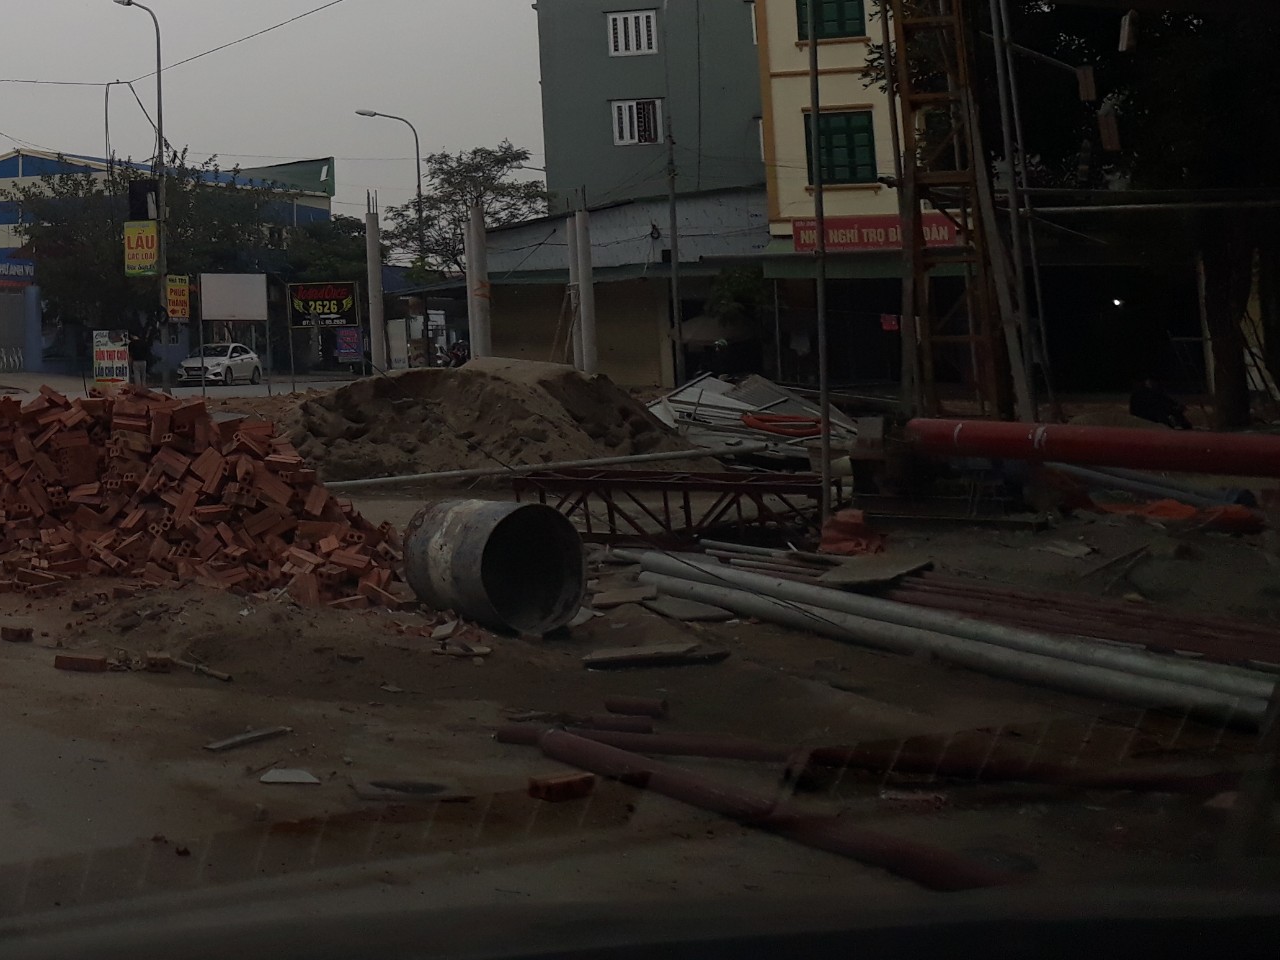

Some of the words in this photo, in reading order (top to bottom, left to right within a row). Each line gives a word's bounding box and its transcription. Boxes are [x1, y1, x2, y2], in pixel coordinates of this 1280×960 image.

[828, 224, 859, 243] NGHỈ
[861, 228, 885, 245] TRỌ
[309, 300, 337, 313] 2626
